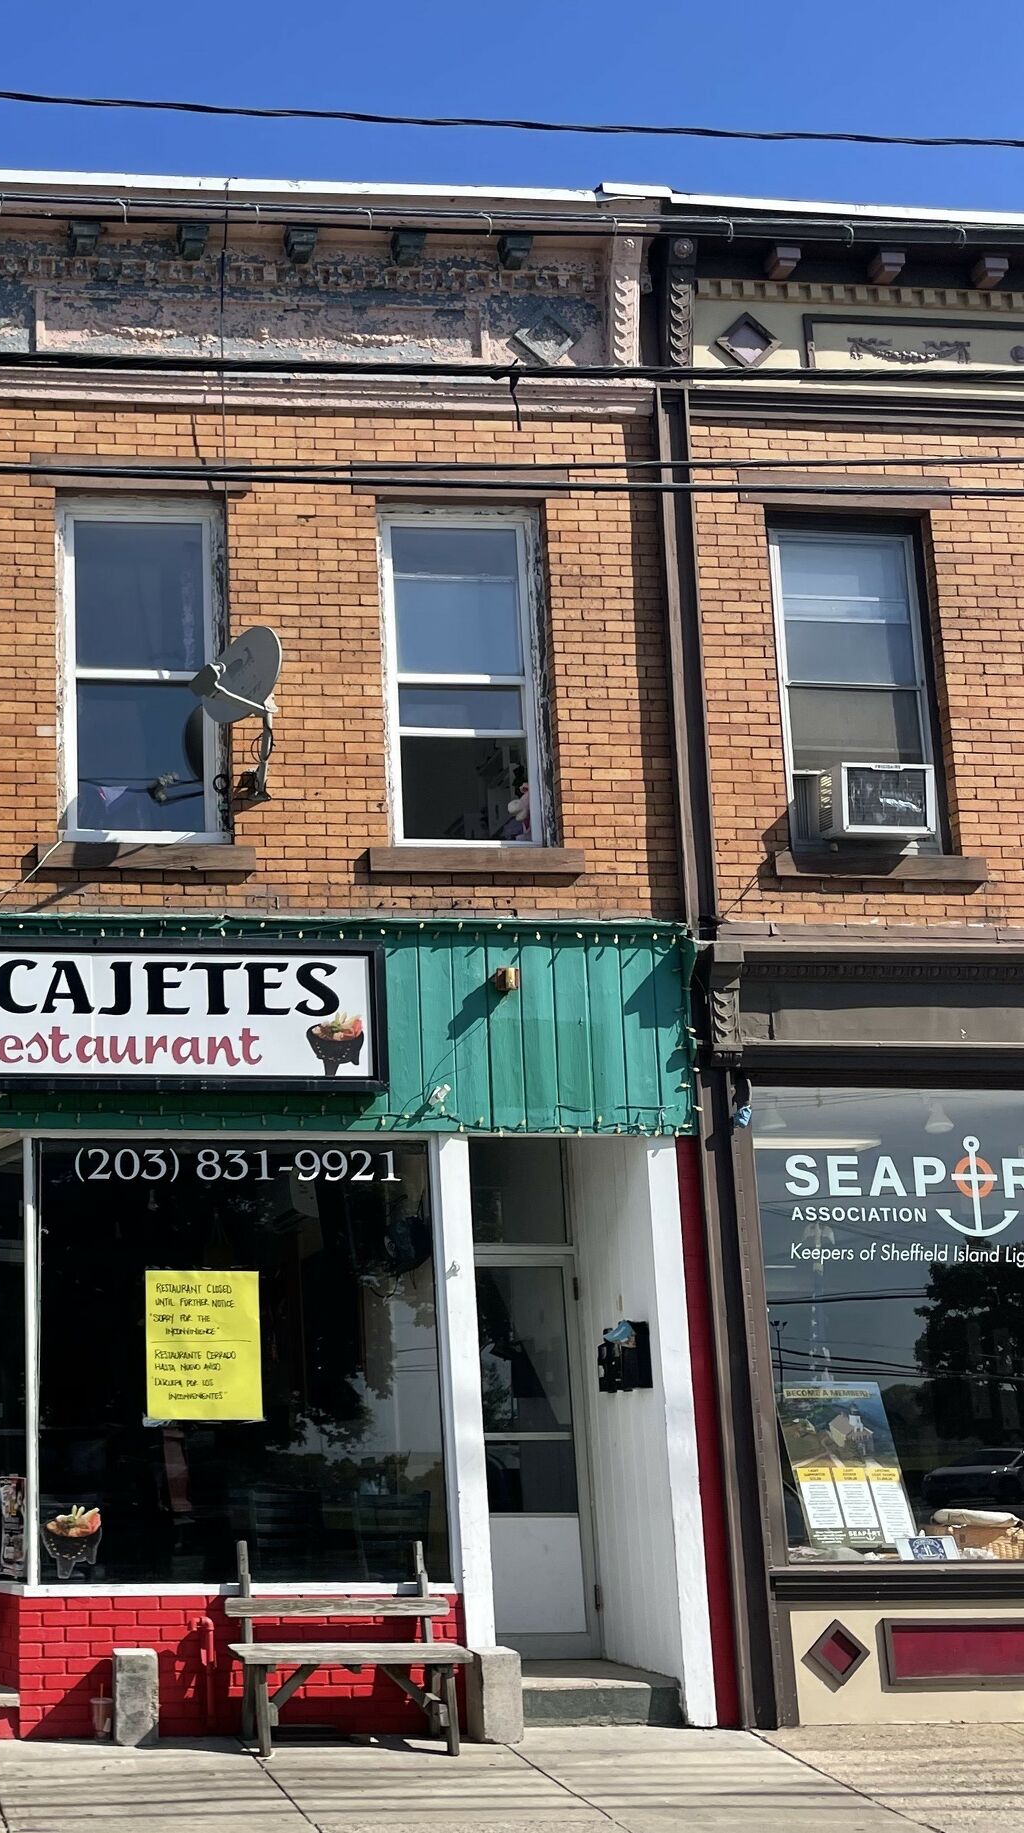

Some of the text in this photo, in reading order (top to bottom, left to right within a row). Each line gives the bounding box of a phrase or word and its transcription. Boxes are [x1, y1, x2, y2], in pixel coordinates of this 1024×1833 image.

[74, 1147, 402, 1183] (203) 831-9921
[790, 1206, 927, 1223] ASSOCIATION
[790, 1242, 855, 1264] Keepers
[860, 1242, 876, 1261] of
[880, 1243, 949, 1262] Sheffield
[953, 1245, 1000, 1263] Island
[155, 1282, 232, 1294] RESTAURANT CLOSED
[155, 1297, 236, 1308] UNTIL FURTHER NOTICE
[197, 1314, 211, 1323] THE
[154, 1349, 203, 1360] RESTAURANTE
